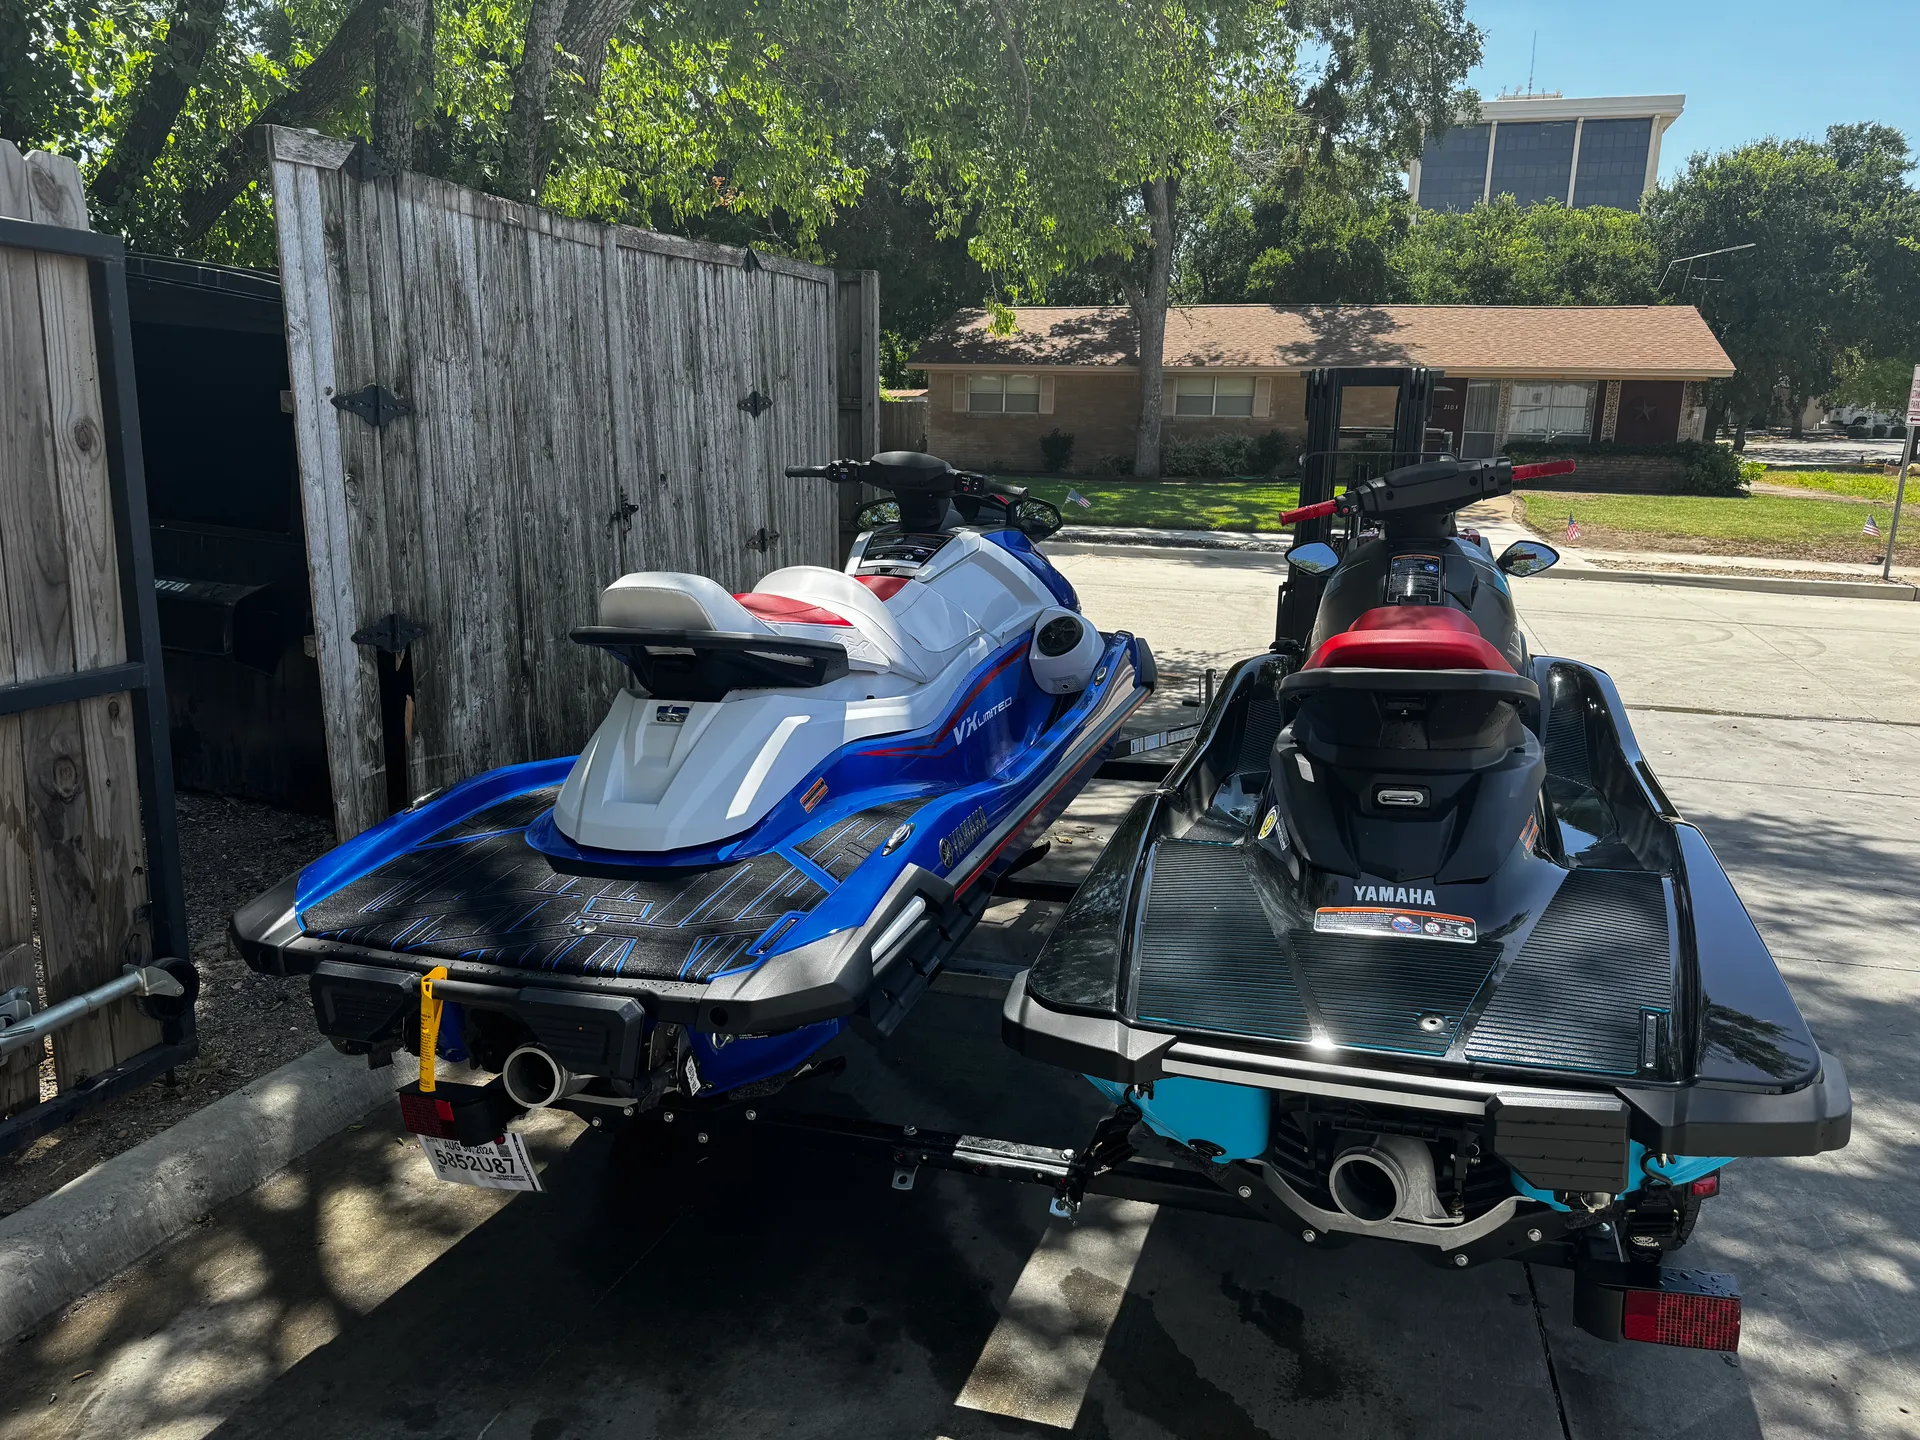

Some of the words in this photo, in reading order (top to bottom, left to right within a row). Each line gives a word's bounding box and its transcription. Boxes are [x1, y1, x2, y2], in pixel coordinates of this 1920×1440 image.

[154, 579, 192, 592] 8781
[953, 710, 978, 746] VX
[978, 696, 1012, 727] LIMITED
[948, 805, 989, 858] YAMAHA
[1353, 885, 1436, 906] YAMAHA
[444, 1141, 461, 1151] AUG
[435, 1149, 515, 1174] 5852U87
